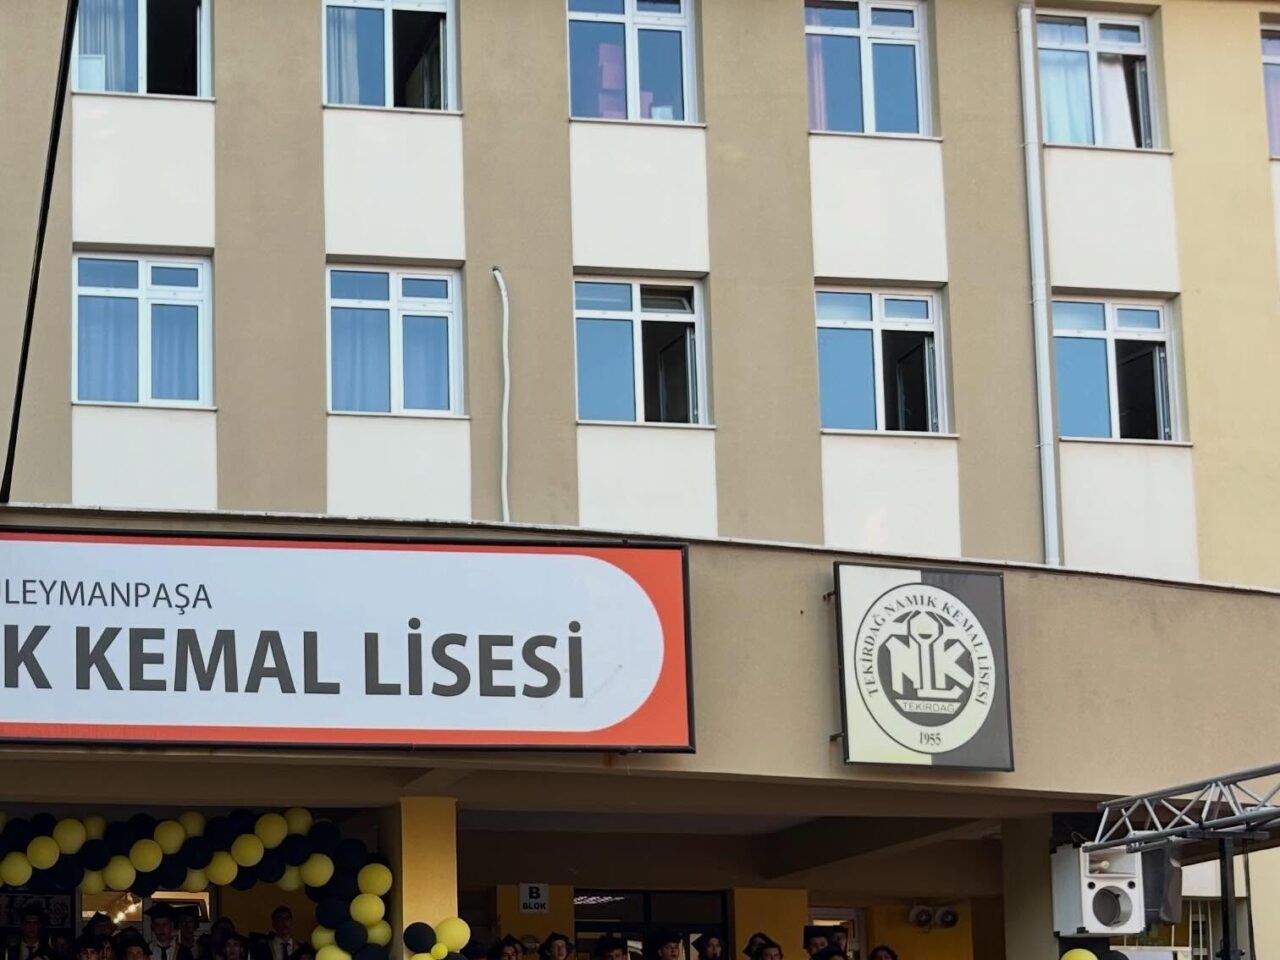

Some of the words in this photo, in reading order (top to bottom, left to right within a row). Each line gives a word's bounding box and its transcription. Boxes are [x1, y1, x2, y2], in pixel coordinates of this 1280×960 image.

[884, 594, 938, 616] NAMIK
[942, 602, 983, 652] KEMAL
[75, 626, 341, 695] KEMAL
[364, 617, 584, 699] LİSESİ
[919, 731, 942, 746] 1955
[528, 886, 540, 899] B
[522, 902, 546, 910] BLOK
